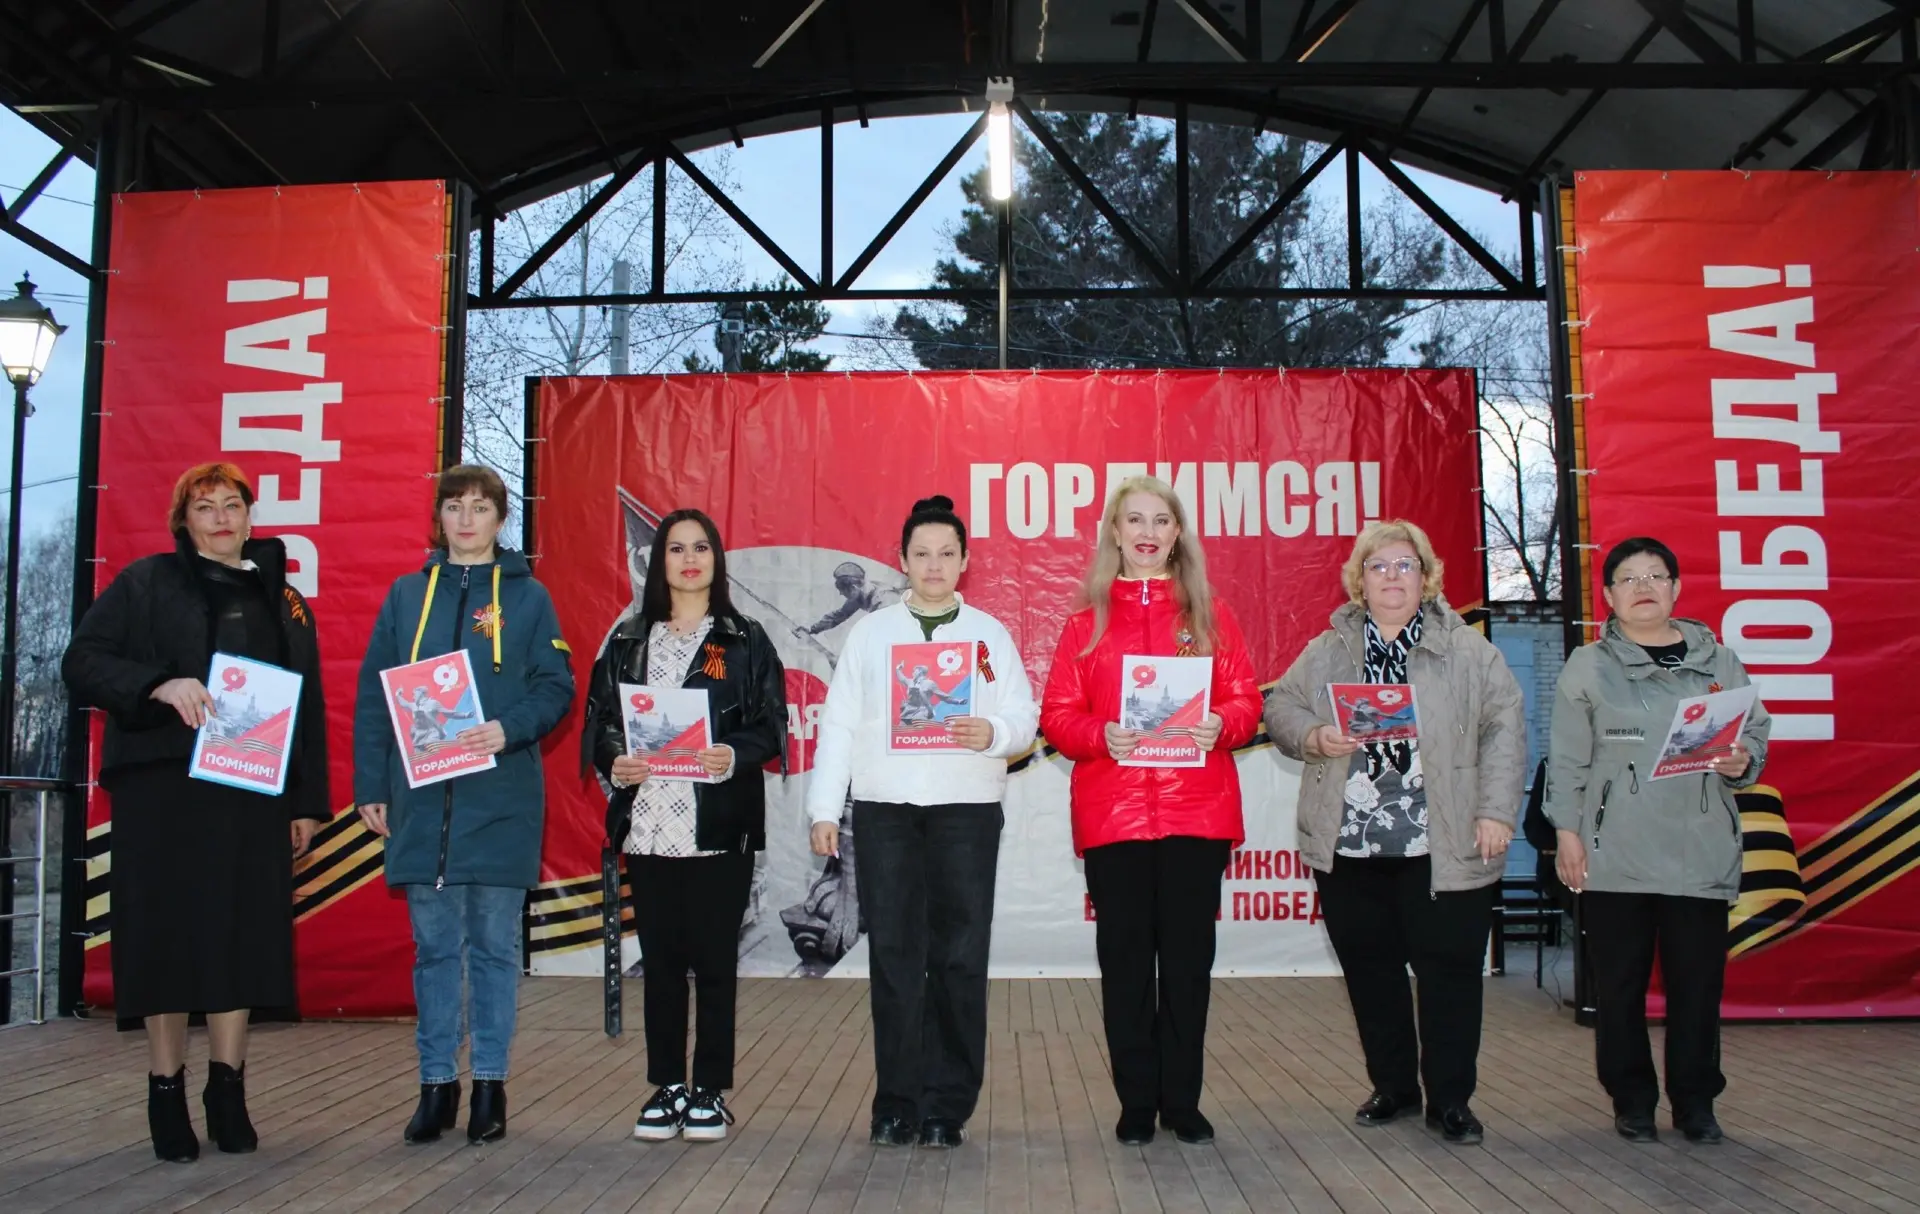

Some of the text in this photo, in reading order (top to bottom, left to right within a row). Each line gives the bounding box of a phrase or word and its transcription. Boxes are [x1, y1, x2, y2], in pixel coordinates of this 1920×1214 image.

[221, 276, 343, 598] ЕДА!
[786, 703, 826, 740] АЯ
[895, 735, 957, 746] ГОРДИМС
[205, 752, 275, 779] ПОМНИМ!
[649, 763, 705, 774] ОМНИМ!
[1659, 759, 1709, 773] ПОМНИ
[1232, 890, 1326, 925] ПОБЕД
